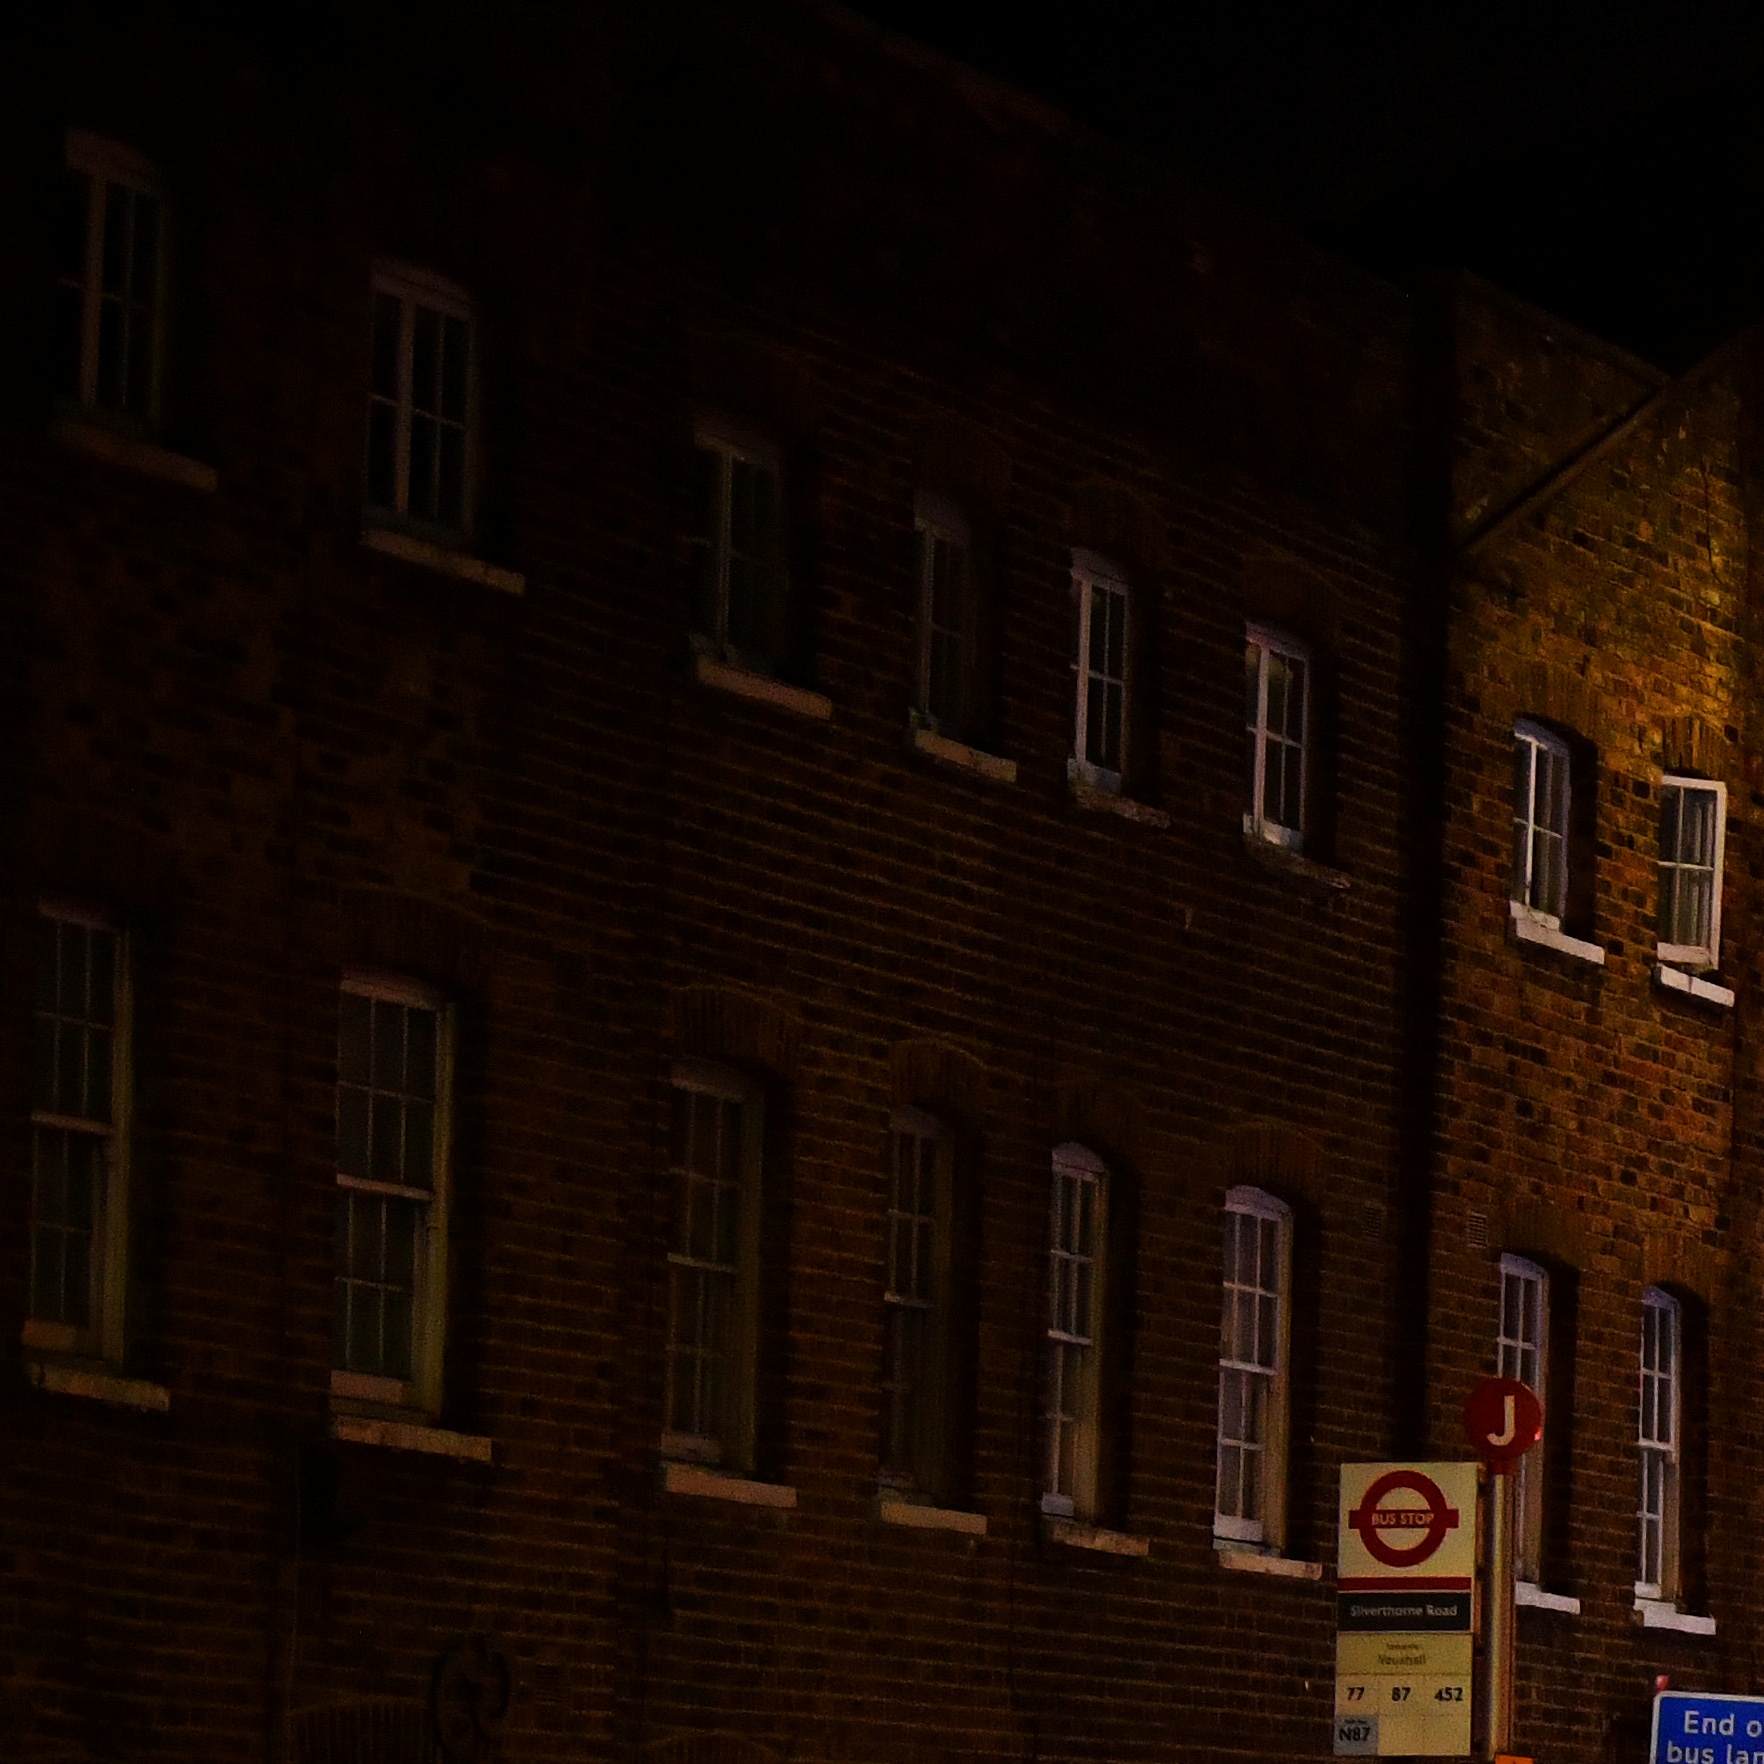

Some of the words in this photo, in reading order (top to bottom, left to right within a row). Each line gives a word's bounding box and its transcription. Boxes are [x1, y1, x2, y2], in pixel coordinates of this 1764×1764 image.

[1486, 1395, 1516, 1447] J
[1371, 1512, 1396, 1526] BUS
[1400, 1512, 1435, 1525] STOP
[1425, 1604, 1458, 1617] Road
[1347, 1686, 1365, 1701] 77
[1391, 1686, 1411, 1702] 87
[1434, 1686, 1464, 1702] 452
[1683, 1709, 1735, 1737] End
[1339, 1727, 1371, 1742] N87
